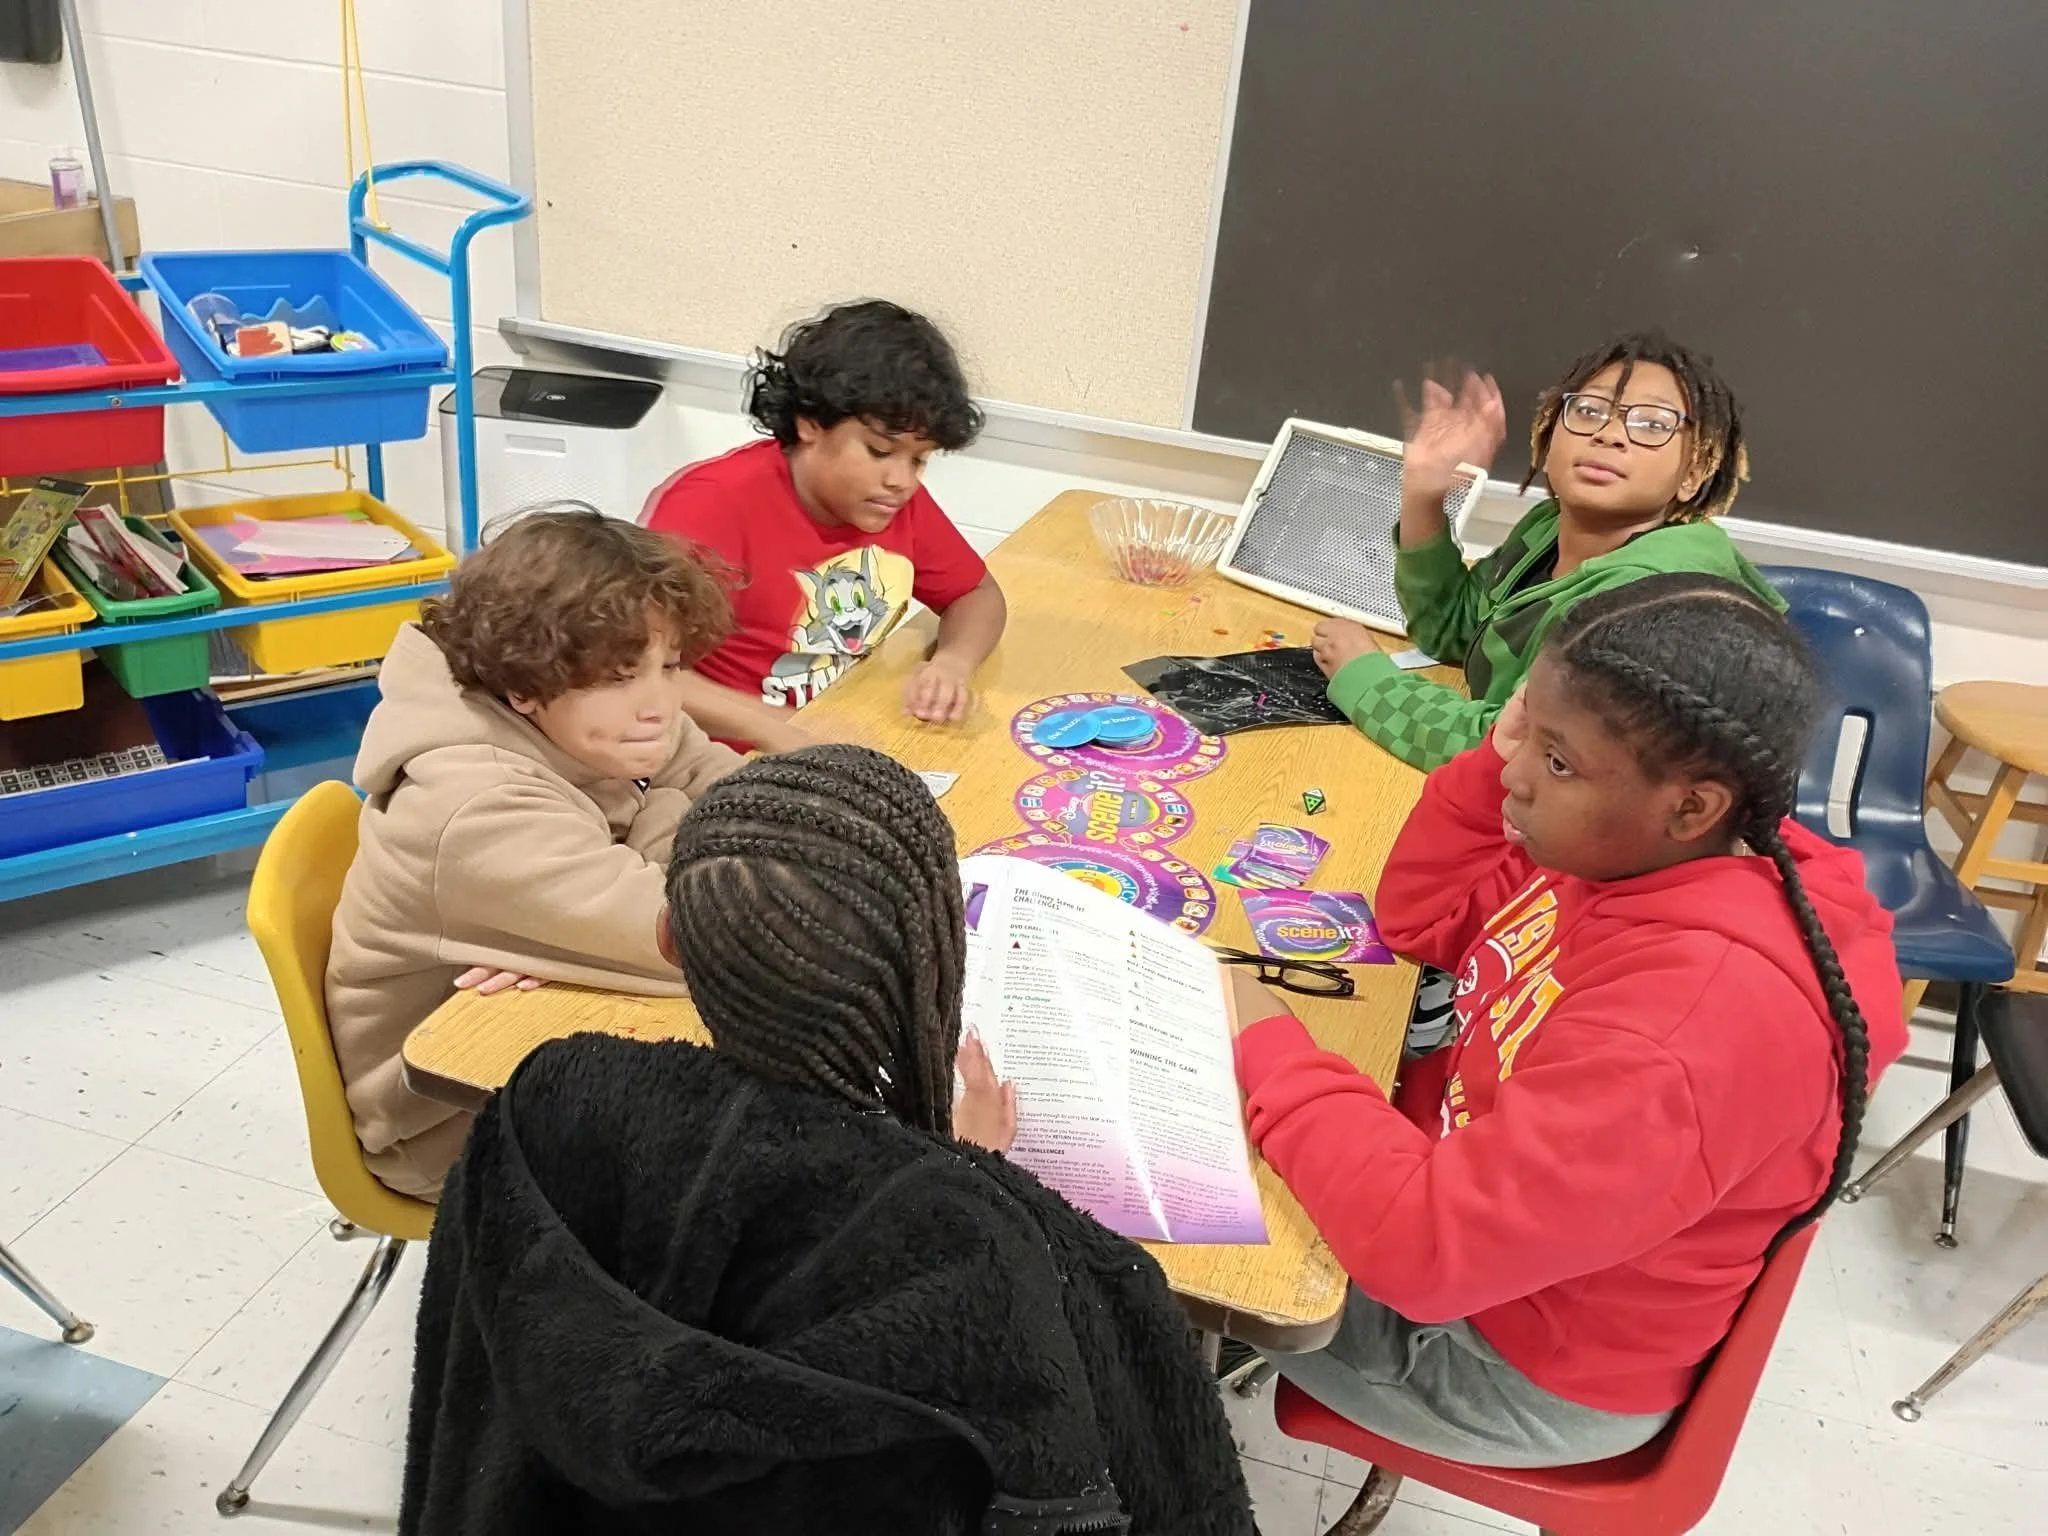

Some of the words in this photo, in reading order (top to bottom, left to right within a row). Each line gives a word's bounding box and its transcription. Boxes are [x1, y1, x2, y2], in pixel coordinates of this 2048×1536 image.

[1085, 770, 1127, 792] it?
[1085, 790, 1124, 844] scene
[1277, 926, 1337, 940] scene
[1129, 1047, 1163, 1063] WINNING
[1164, 1057, 1178, 1068] THE
[1027, 1146, 1065, 1155] CHALLENGES
